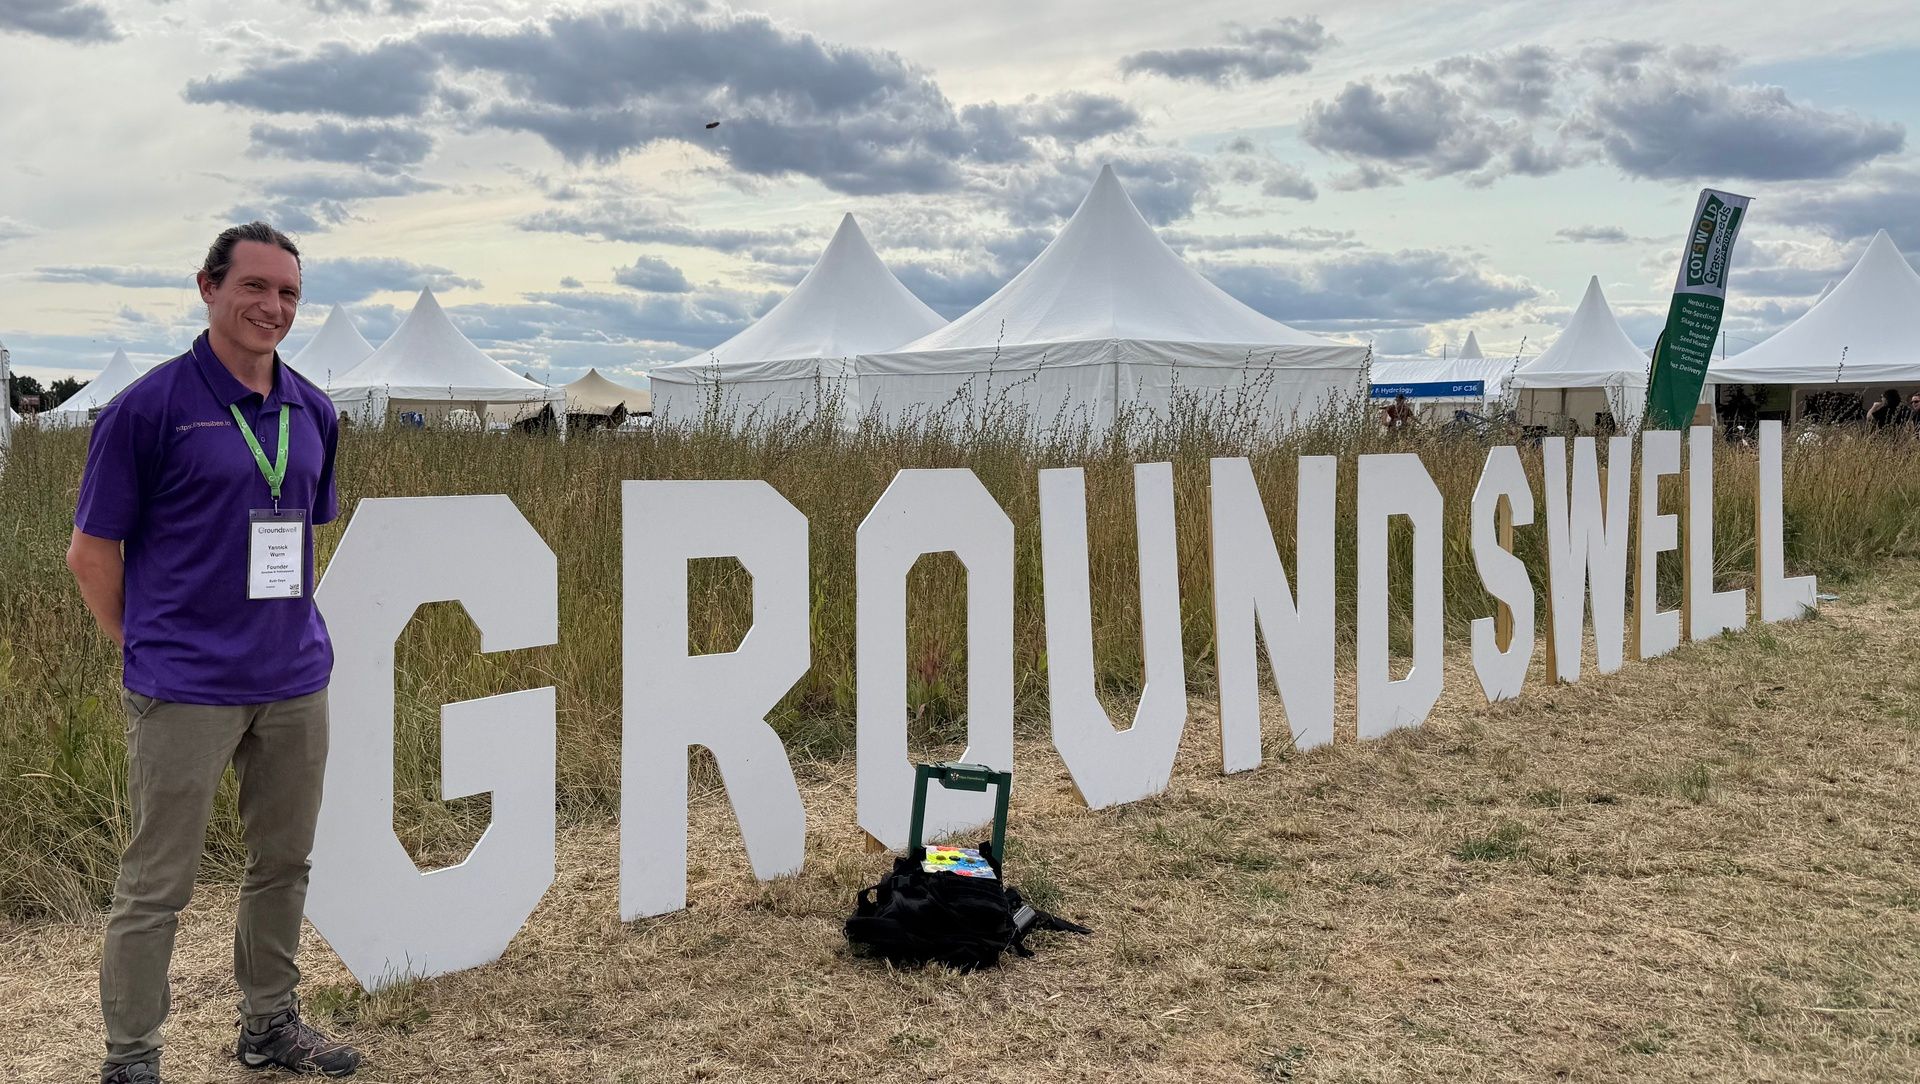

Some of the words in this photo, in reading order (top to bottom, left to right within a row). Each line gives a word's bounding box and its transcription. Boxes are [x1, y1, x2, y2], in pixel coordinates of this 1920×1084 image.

[1690, 203, 1718, 279] COTSWOLD
[1704, 248, 1722, 284] Grass
[1715, 205, 1732, 244] Seeds
[1688, 298, 1705, 308] Herbal
[1705, 302, 1720, 311] Leys
[1701, 323, 1714, 332] Hay
[1680, 335, 1693, 344] Seed
[1692, 338, 1708, 348] Mixes
[1679, 363, 1702, 376] Delivery
[1381, 386, 1414, 395] Hydrology
[1463, 384, 1478, 392] C36
[258, 526, 297, 534] Groundswell
[305, 420, 1817, 990] GROUNDSWELL
